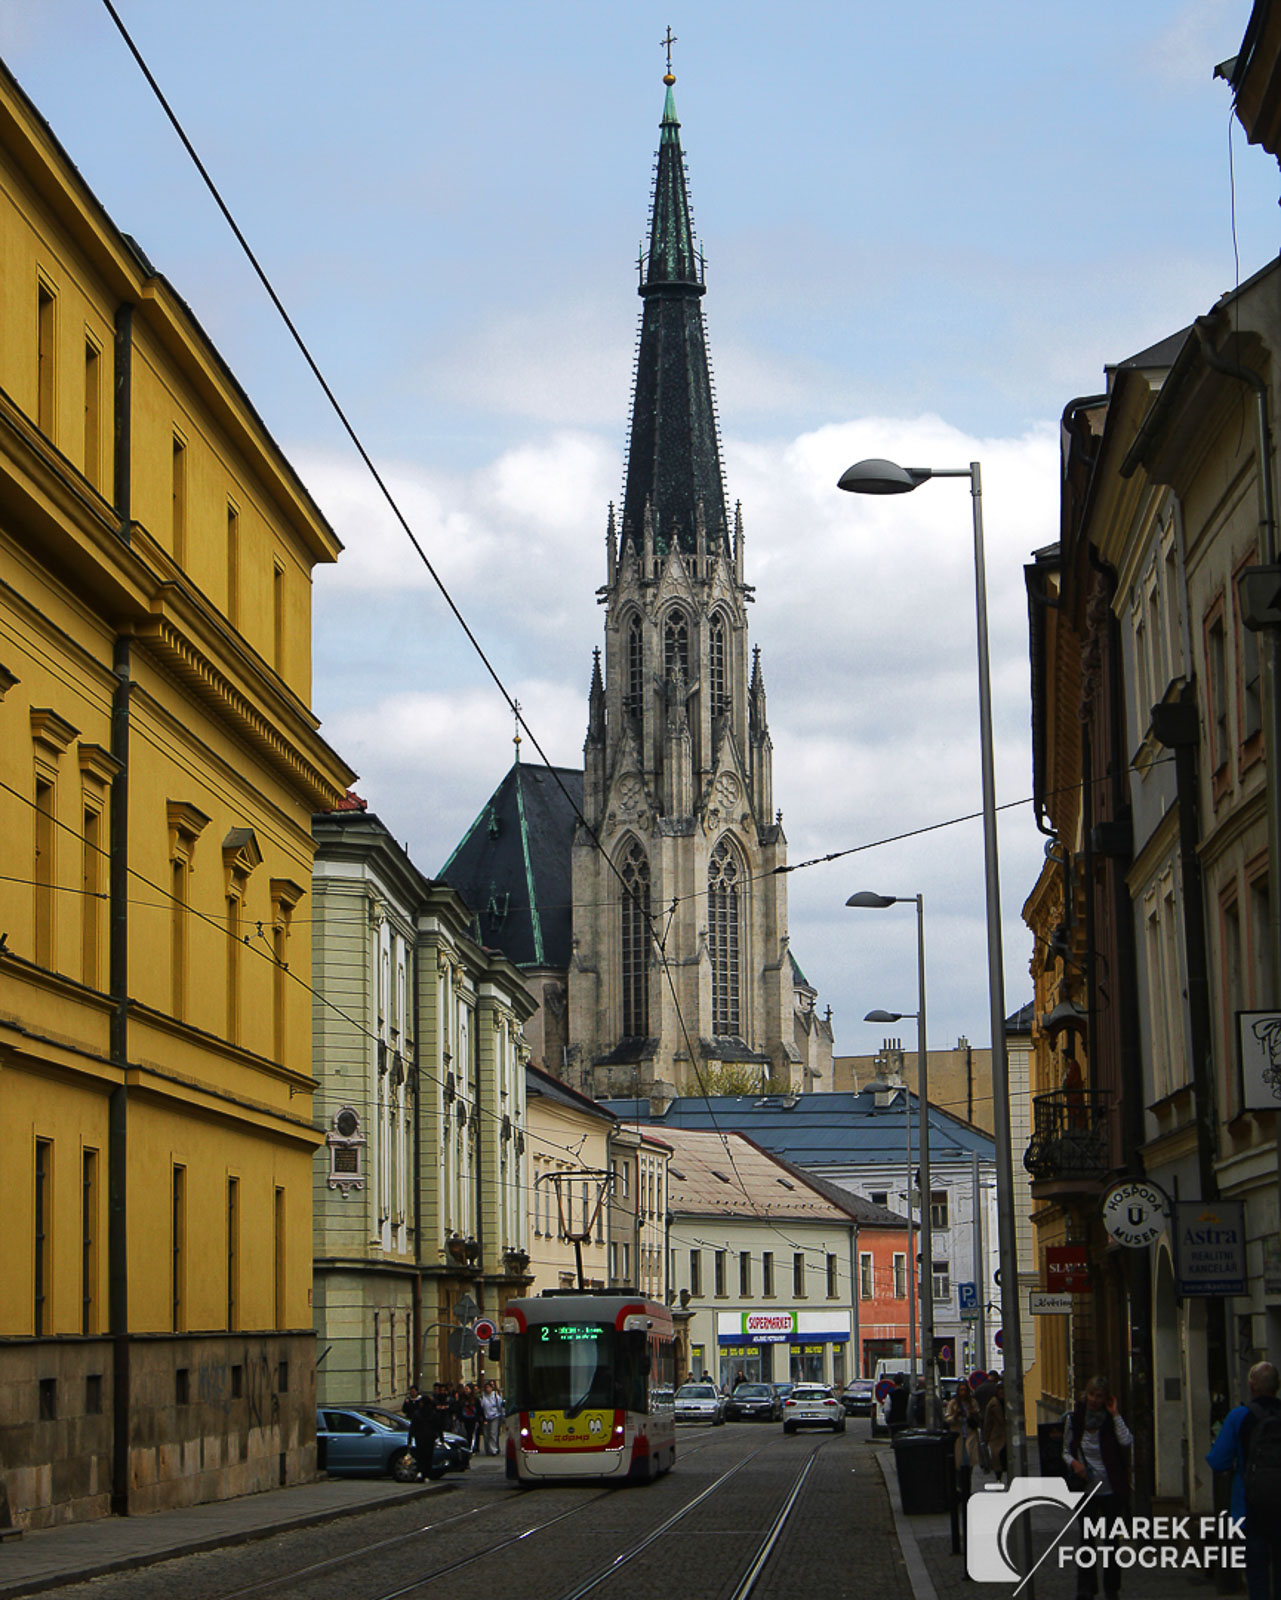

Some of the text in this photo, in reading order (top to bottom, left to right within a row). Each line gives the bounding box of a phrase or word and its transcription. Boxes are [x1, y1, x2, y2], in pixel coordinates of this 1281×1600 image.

[1108, 1185, 1162, 1212] HOSPODA
[1128, 1208, 1143, 1225] U
[1113, 1227, 1159, 1244] MUSEA
[1183, 1227, 1237, 1245] Astra
[962, 1286, 974, 1302] P
[748, 1316, 792, 1330] SUPERMARKET
[541, 1327, 549, 1341] 2
